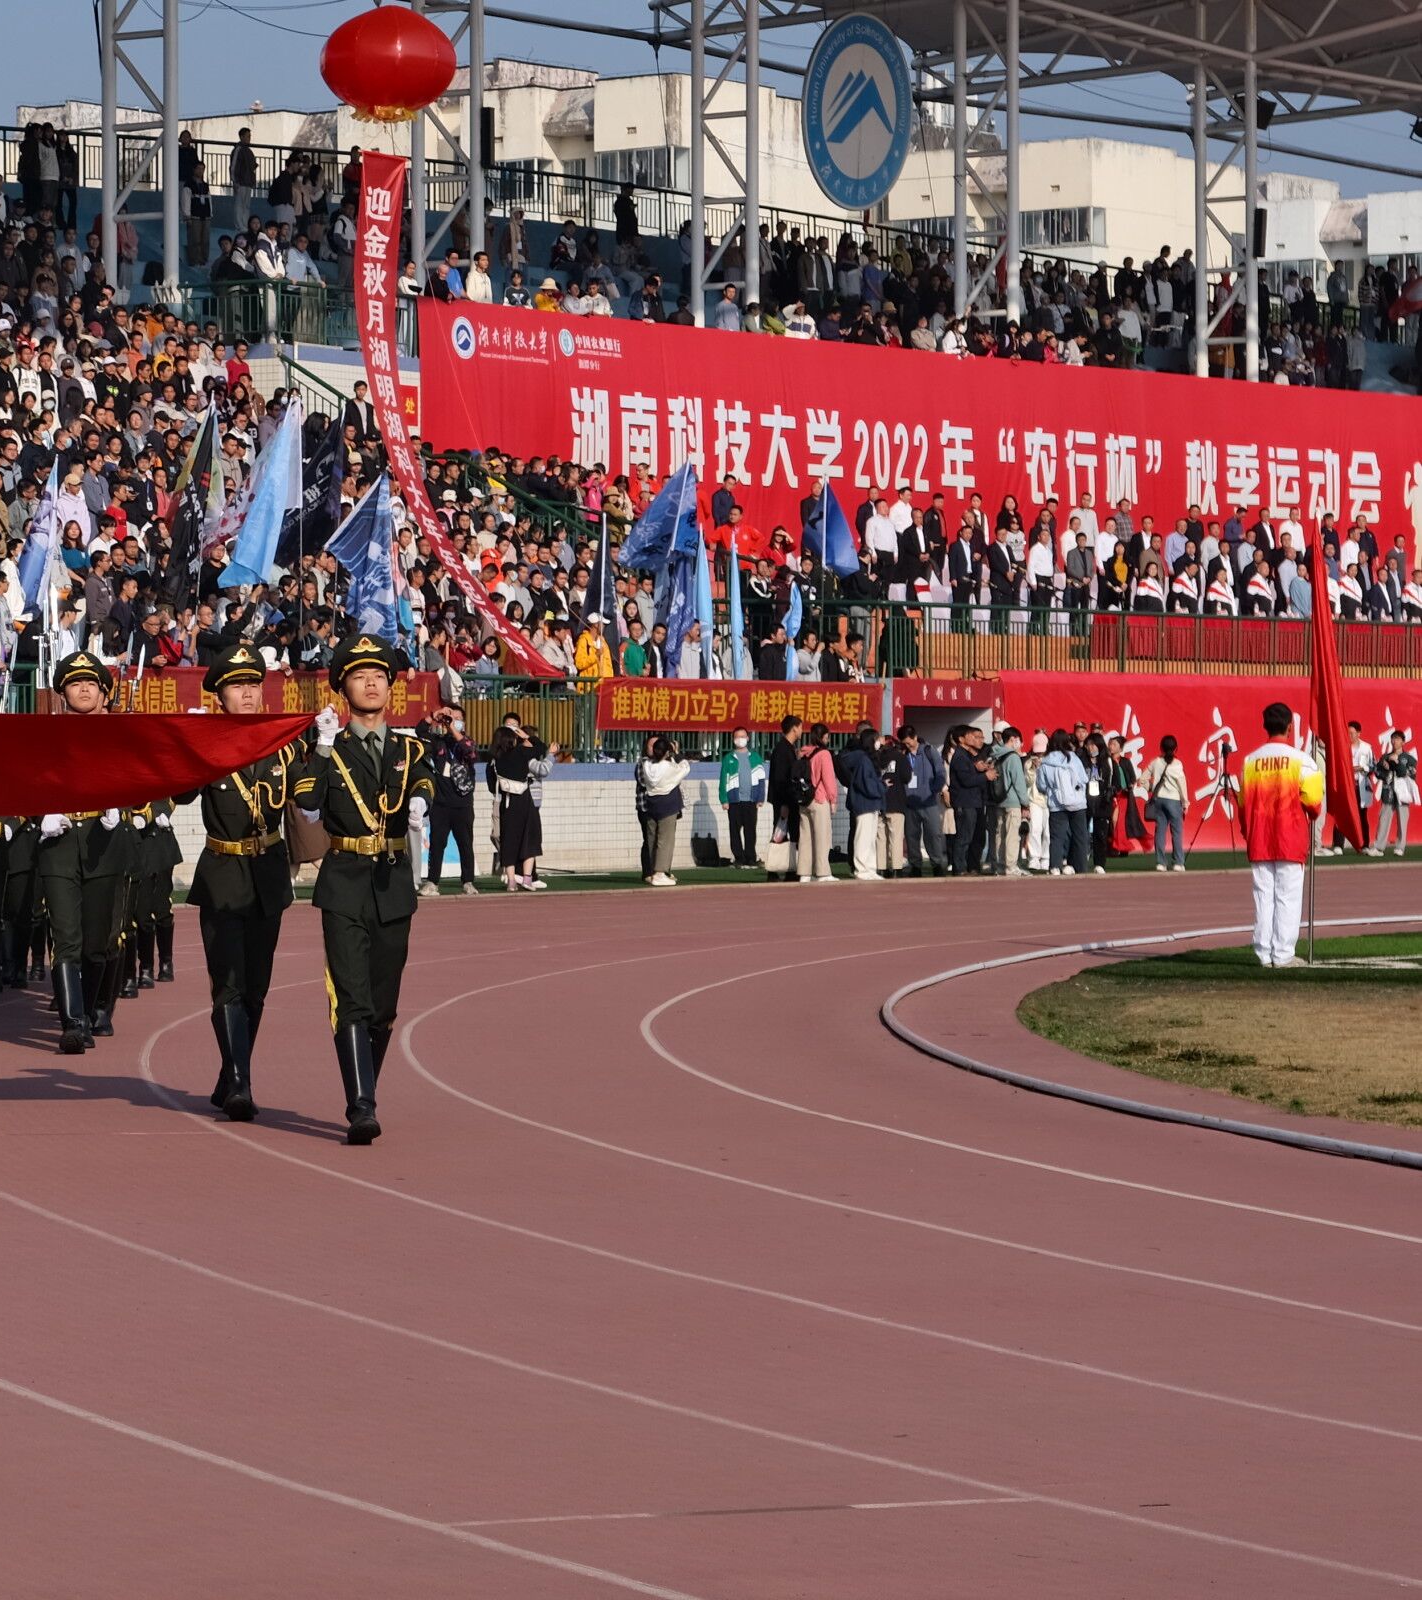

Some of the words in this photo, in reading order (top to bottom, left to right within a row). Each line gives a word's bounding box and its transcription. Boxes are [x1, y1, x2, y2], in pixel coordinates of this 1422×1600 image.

[575, 334, 621, 353] 中国农业银行
[1254, 756, 1290, 772] CHINA
